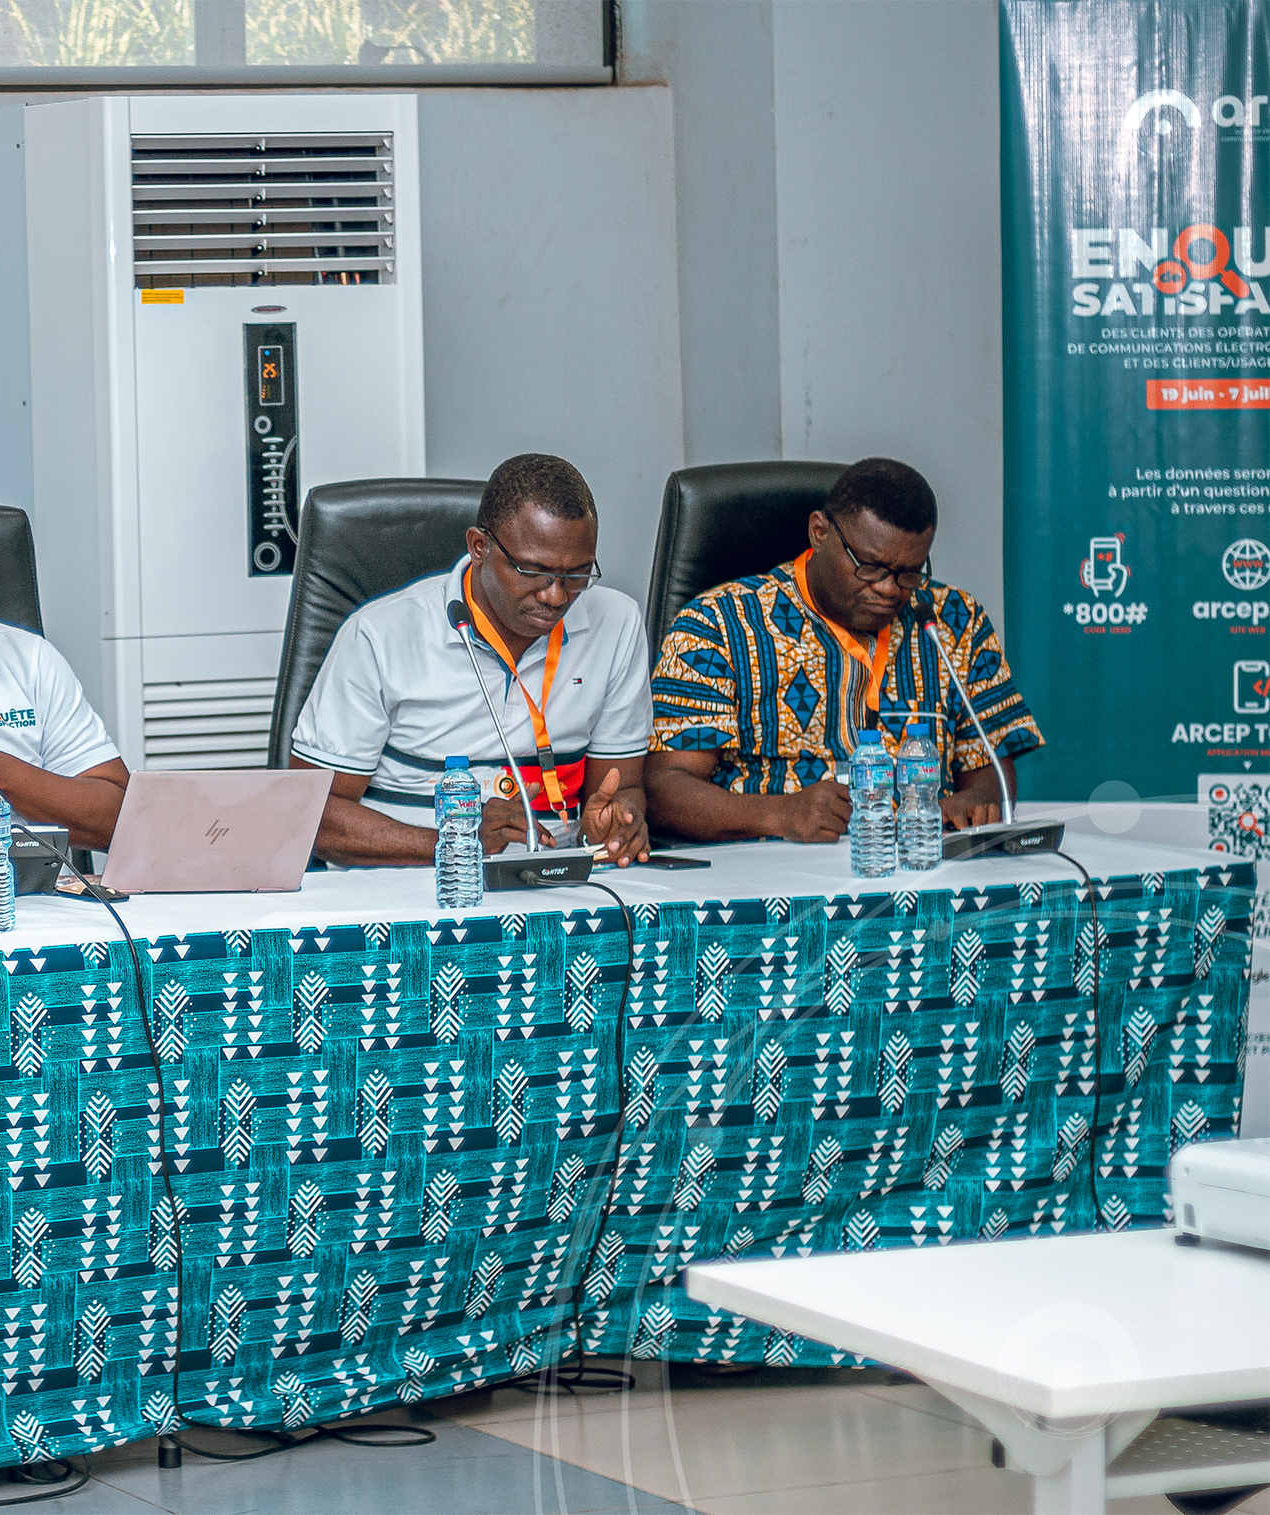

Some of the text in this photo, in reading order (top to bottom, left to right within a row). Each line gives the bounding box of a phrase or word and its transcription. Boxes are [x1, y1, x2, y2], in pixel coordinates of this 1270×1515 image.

[1101, 327, 1128, 339] DES
[1132, 327, 1184, 339] CLIENTS
[1188, 326, 1214, 338] DES
[1067, 343, 1085, 355] DE
[1089, 341, 1212, 354] COMMUNICATIONS
[1124, 357, 1138, 369] ET
[1143, 357, 1168, 369] DES
[1161, 388, 1178, 401] 19
[1182, 386, 1214, 404] juin
[1228, 387, 1239, 401] 7
[1136, 467, 1161, 481] Les
[1165, 466, 1229, 480] données
[1108, 482, 1269, 500] à partir d'un question
[1171, 501, 1265, 515] à travers ces
[1171, 722, 1270, 744] ARCEP T
